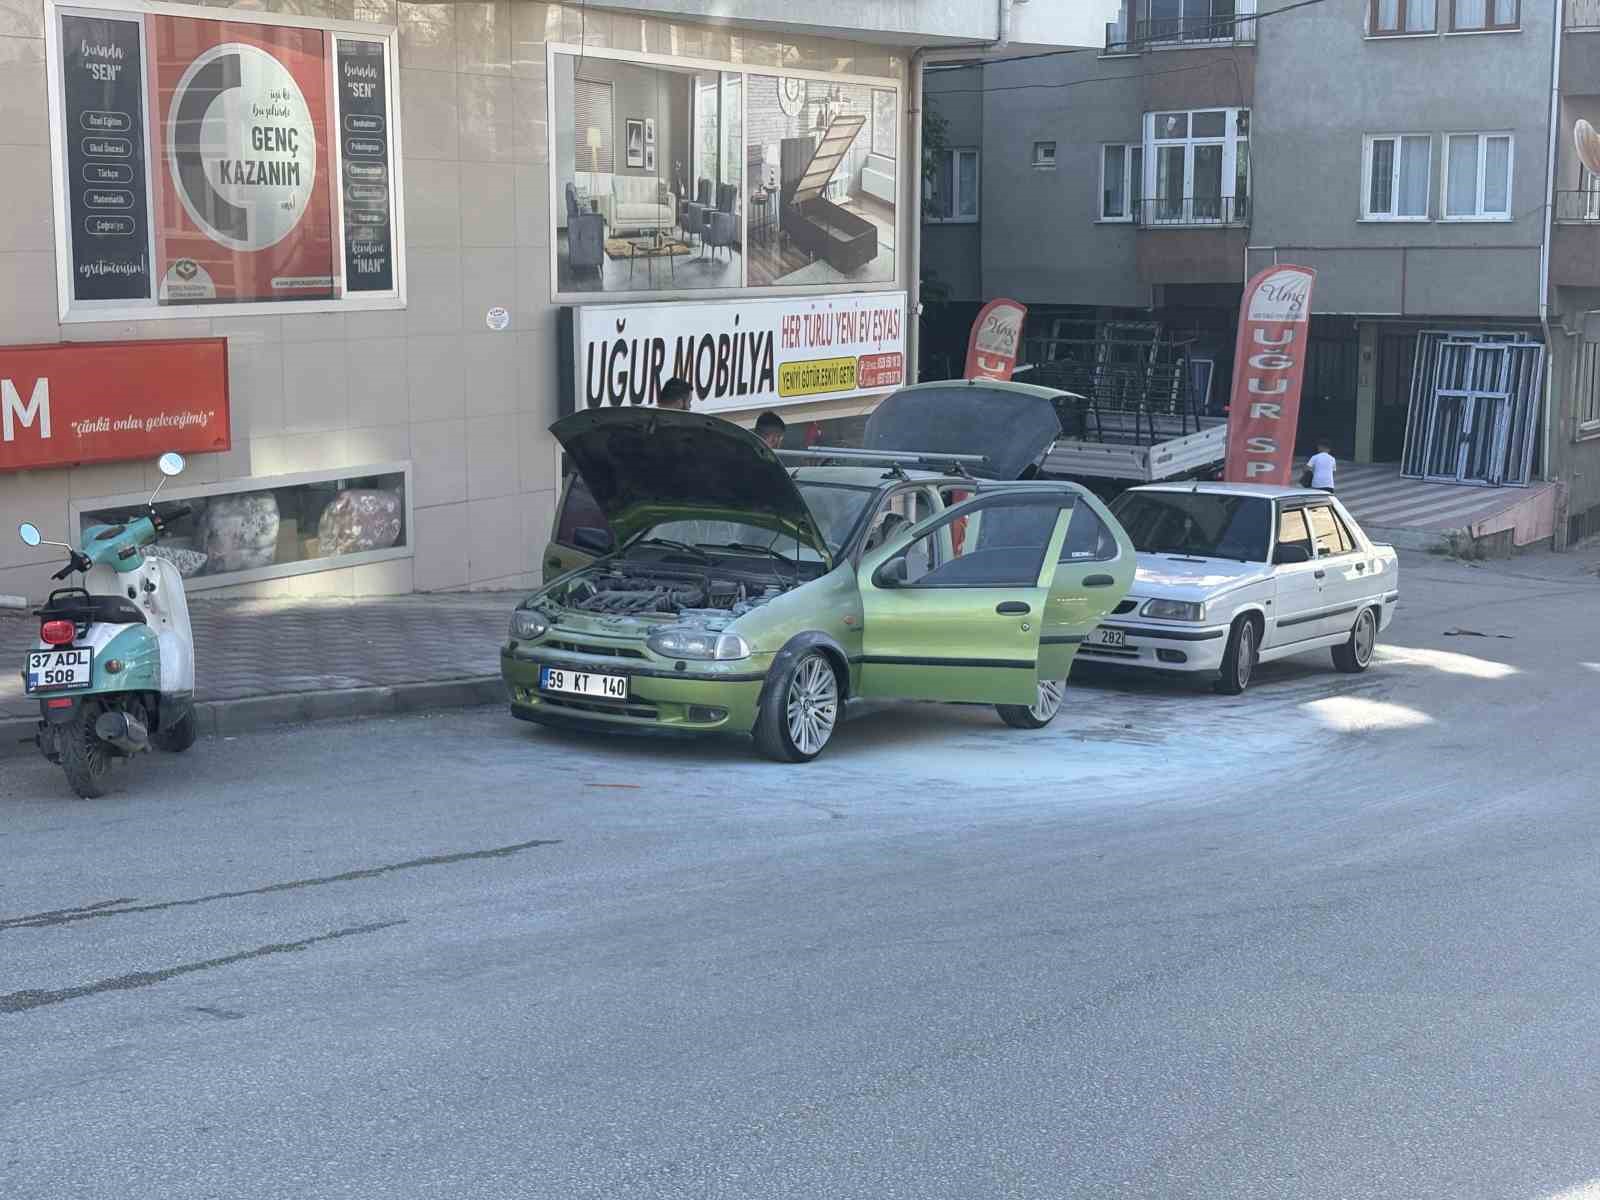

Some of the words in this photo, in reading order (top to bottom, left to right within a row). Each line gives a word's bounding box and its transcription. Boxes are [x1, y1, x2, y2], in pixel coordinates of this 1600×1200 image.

[252, 126, 299, 157] GENÇ
[220, 160, 301, 187] KAZANIM
[781, 314, 801, 349] HER
[804, 303, 833, 348] TÜRLÜ
[835, 301, 858, 345] YENİ
[860, 310, 872, 343] EV
[873, 308, 900, 351] EŞYASI
[586, 318, 666, 407] UĞUR
[673, 314, 775, 401] MOBİLYA
[1, 377, 50, 441] M
[113, 414, 143, 431] onlar
[31, 654, 50, 668] 37
[55, 652, 88, 667] ADL
[44, 669, 75, 684] 508
[549, 671, 564, 688] 59
[574, 673, 591, 692] KT
[602, 677, 625, 697] 140
